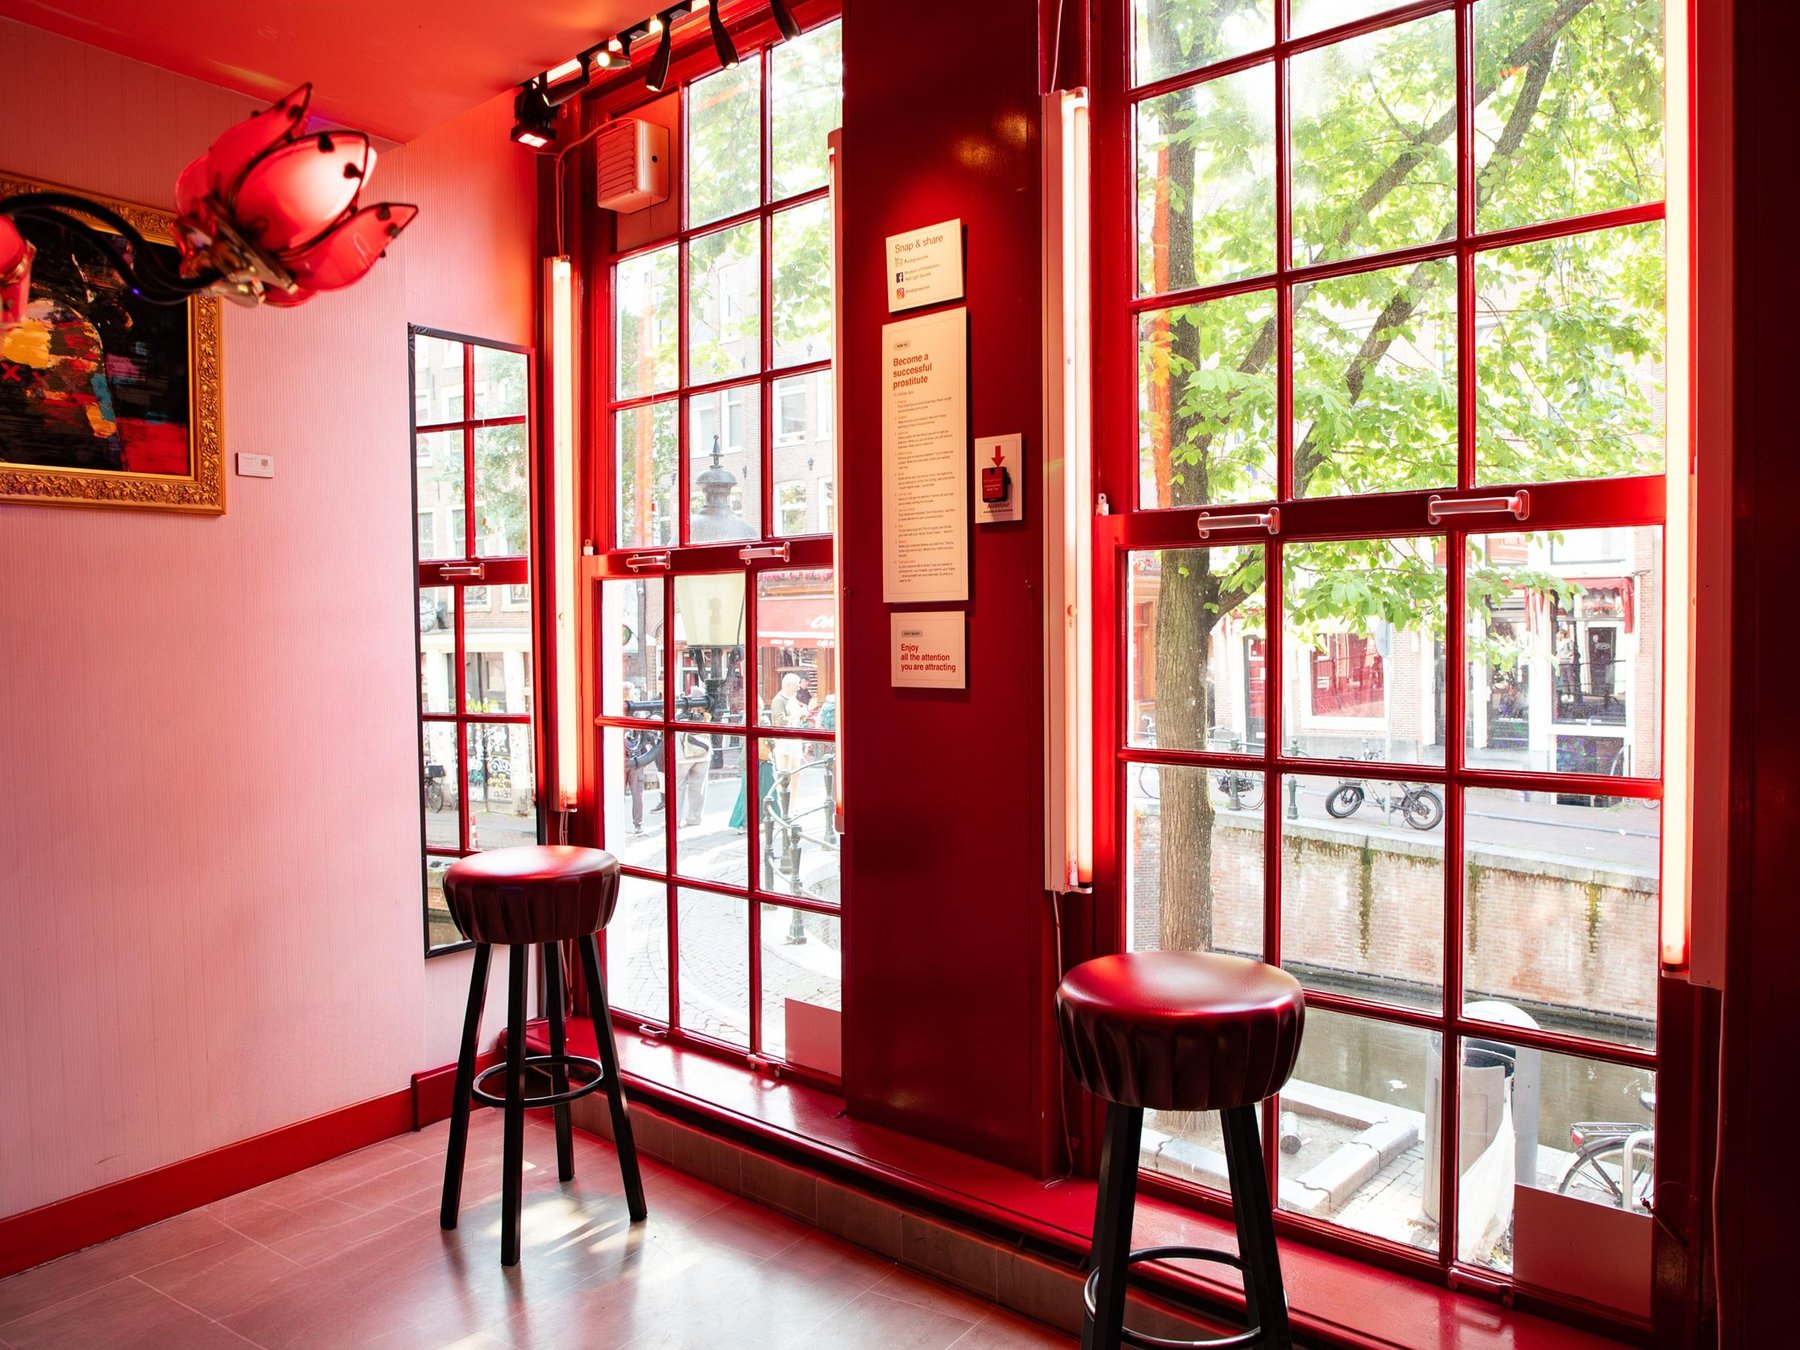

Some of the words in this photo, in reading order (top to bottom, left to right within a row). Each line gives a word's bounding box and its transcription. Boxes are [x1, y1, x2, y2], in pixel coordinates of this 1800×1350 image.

[894, 242, 914, 254] Snap
[915, 239, 921, 248] &
[922, 234, 944, 246] share
[893, 354, 923, 367] Become
[924, 353, 929, 361] a
[893, 362, 932, 378] successful
[893, 375, 929, 390] prostitute
[901, 643, 919, 653] Enjoy
[901, 653, 909, 661] all
[909, 653, 920, 661] the
[921, 653, 950, 661] attention
[901, 664, 912, 672] you
[925, 663, 956, 672] attracting
